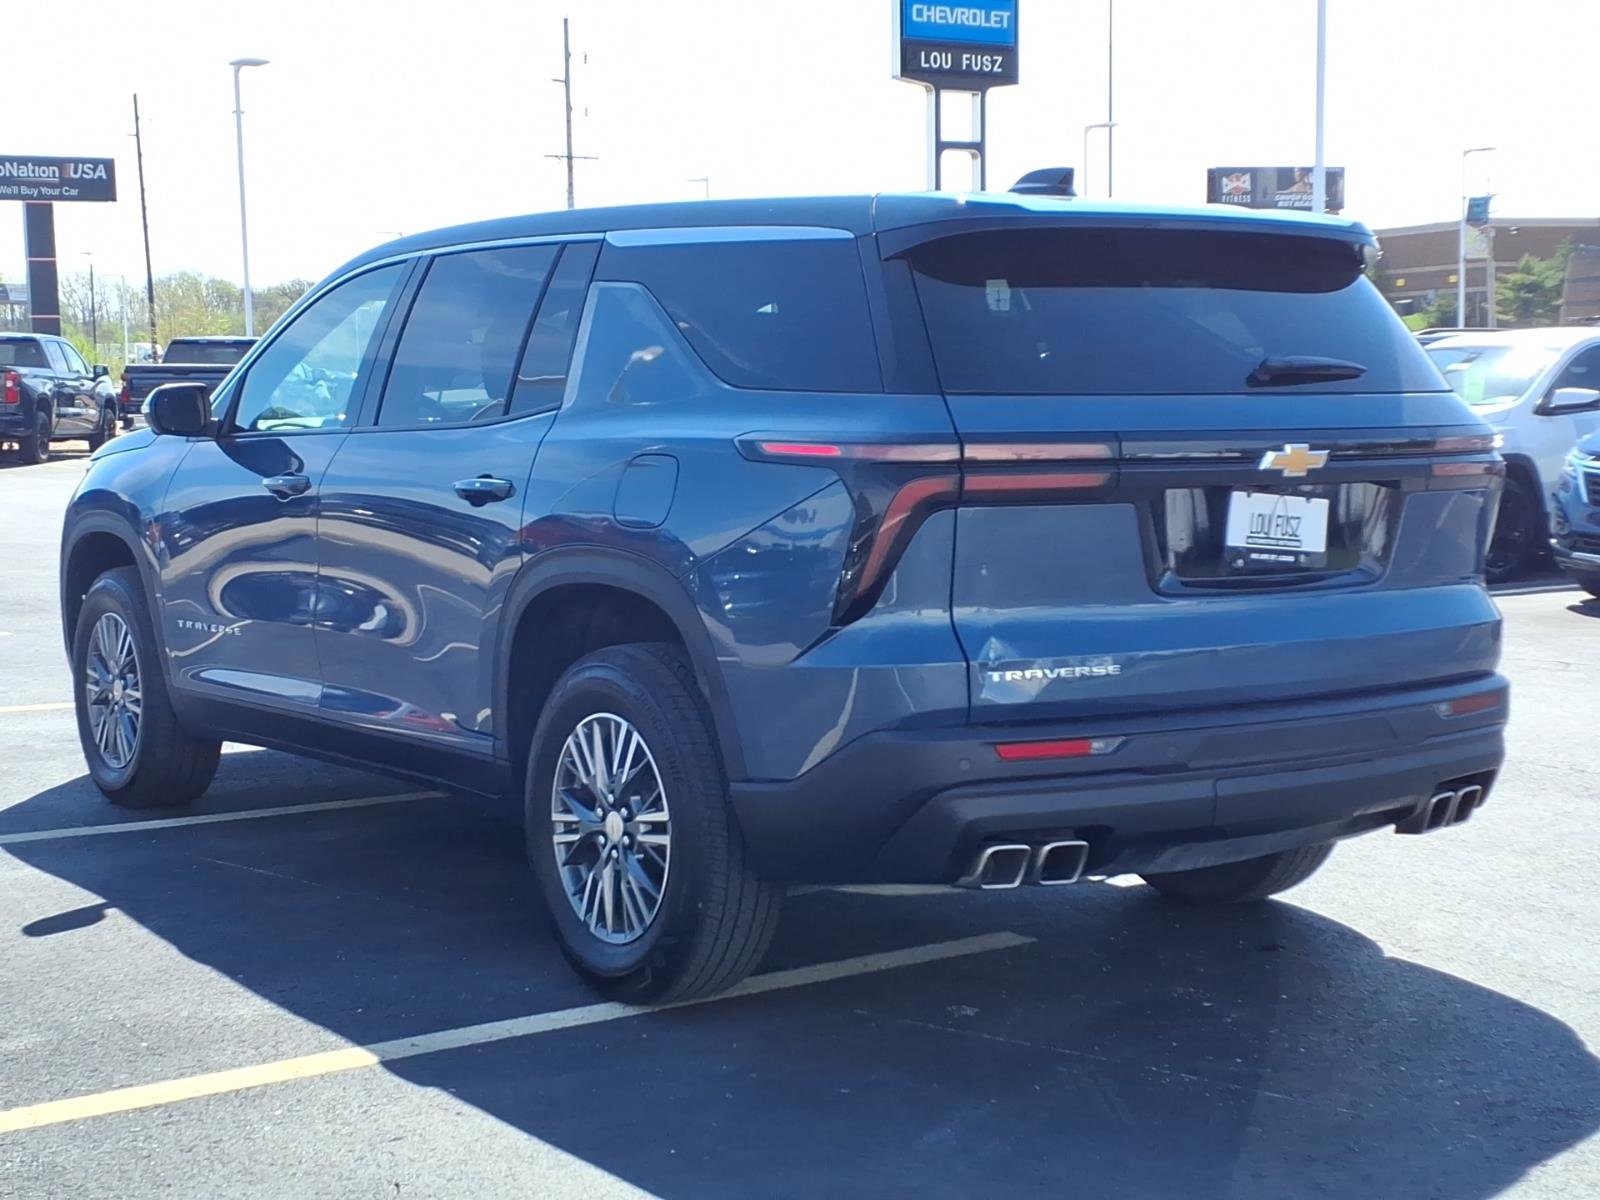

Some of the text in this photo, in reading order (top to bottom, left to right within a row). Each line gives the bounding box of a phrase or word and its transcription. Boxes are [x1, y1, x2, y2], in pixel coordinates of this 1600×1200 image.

[911, 4, 1011, 28] CHEVROLET
[920, 51, 1003, 72] LOU FUSZ
[70, 163, 107, 179] USA
[20, 186, 39, 197] Buy
[40, 187, 60, 196] Your
[62, 187, 79, 196] Car
[1249, 512, 1302, 537] LOU FUSZ
[177, 619, 242, 636] TRAVERSE
[987, 664, 1122, 683] TRAVERSE
